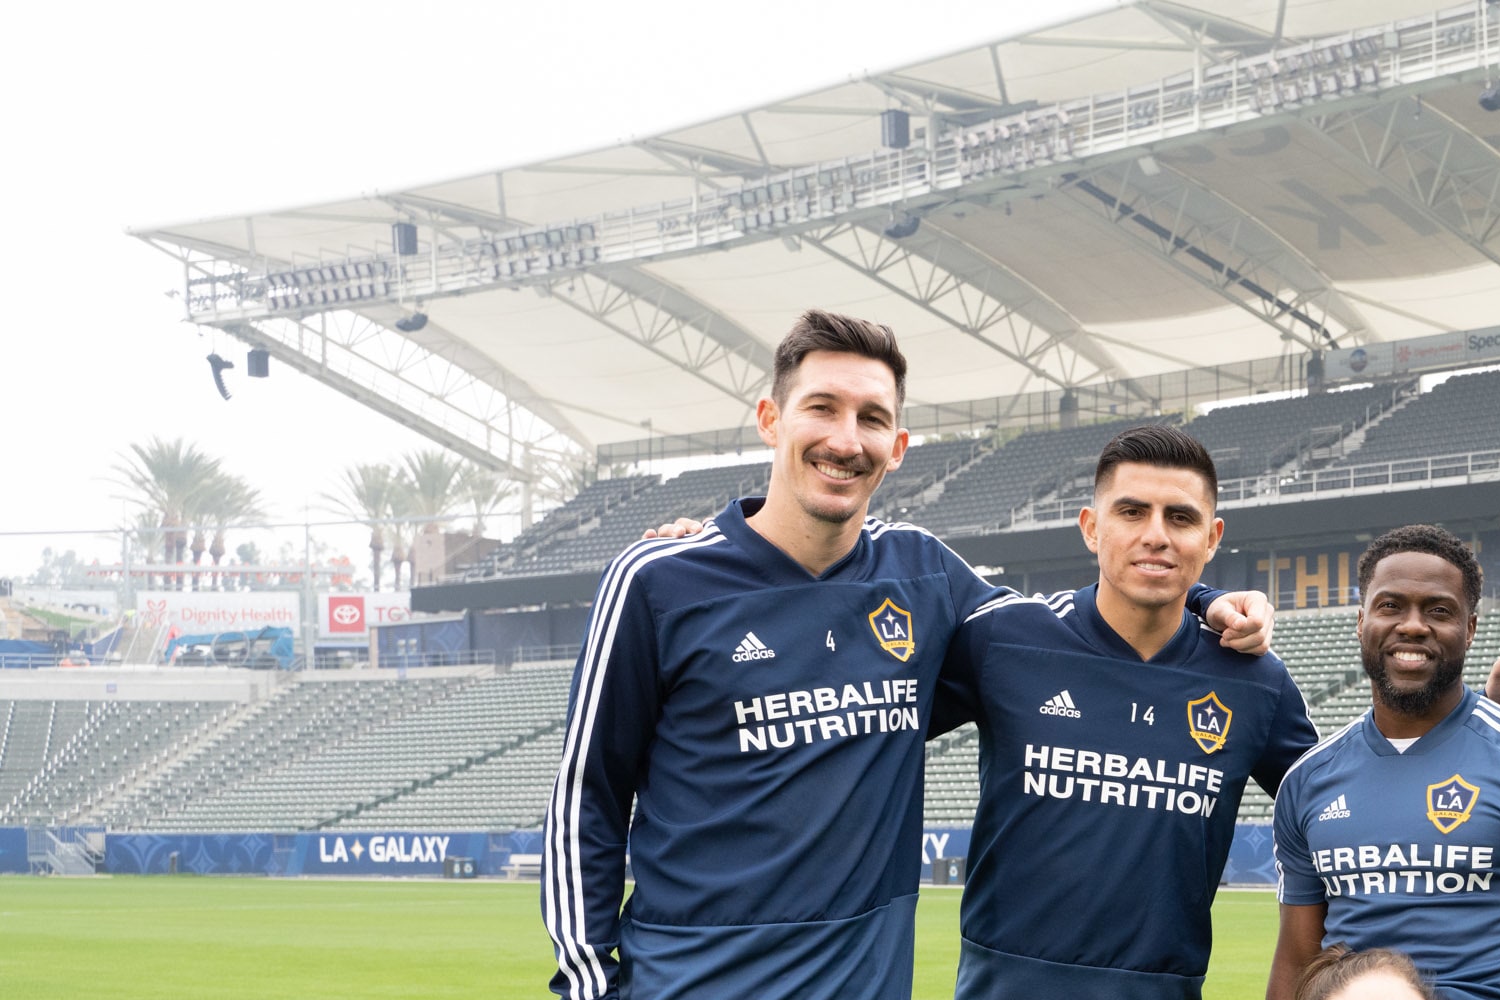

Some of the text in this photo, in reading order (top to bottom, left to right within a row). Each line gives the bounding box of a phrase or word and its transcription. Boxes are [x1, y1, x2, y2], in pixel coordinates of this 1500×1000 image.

[181, 606, 294, 625] Dignity Health
[826, 630, 836, 652] 4
[881, 623, 907, 639] LA
[732, 648, 776, 663] adidas
[734, 679, 918, 725] HERBALIFE
[1039, 704, 1082, 719] adidas
[1131, 702, 1155, 726] 14
[1197, 712, 1221, 733] LA
[738, 707, 920, 752] NUTRITION
[1024, 744, 1224, 794] HERBALIFE
[1023, 771, 1217, 819] NUTRITION
[1437, 794, 1463, 810] LA
[1318, 809, 1351, 822] adidas
[319, 836, 450, 864] LA GALAXY
